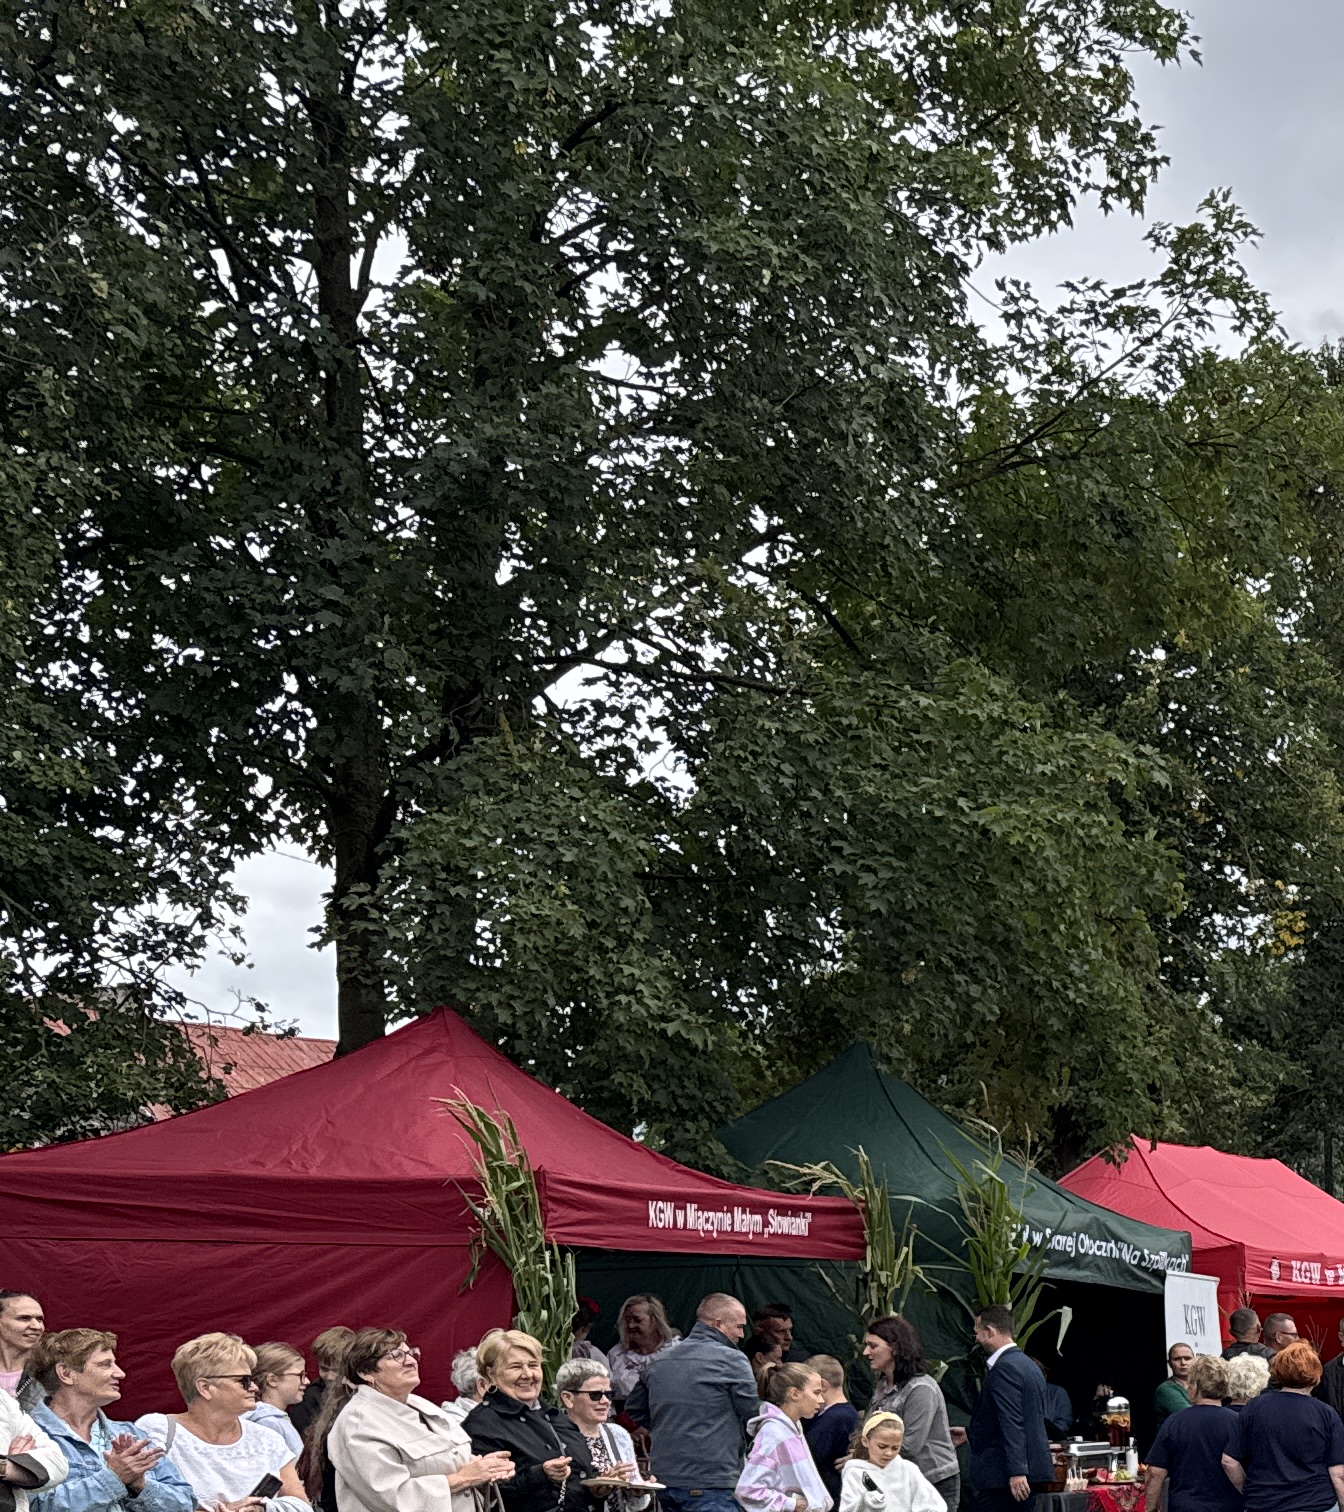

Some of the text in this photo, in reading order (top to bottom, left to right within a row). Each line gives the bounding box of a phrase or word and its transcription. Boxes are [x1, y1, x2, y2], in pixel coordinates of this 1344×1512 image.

[648, 1200, 674, 1229] KGW
[676, 1208, 685, 1229] w
[686, 1202, 732, 1238] Miączynie
[733, 1206, 763, 1240] Małym
[1291, 1260, 1322, 1285] KGW
[1183, 1303, 1206, 1336] KGW
